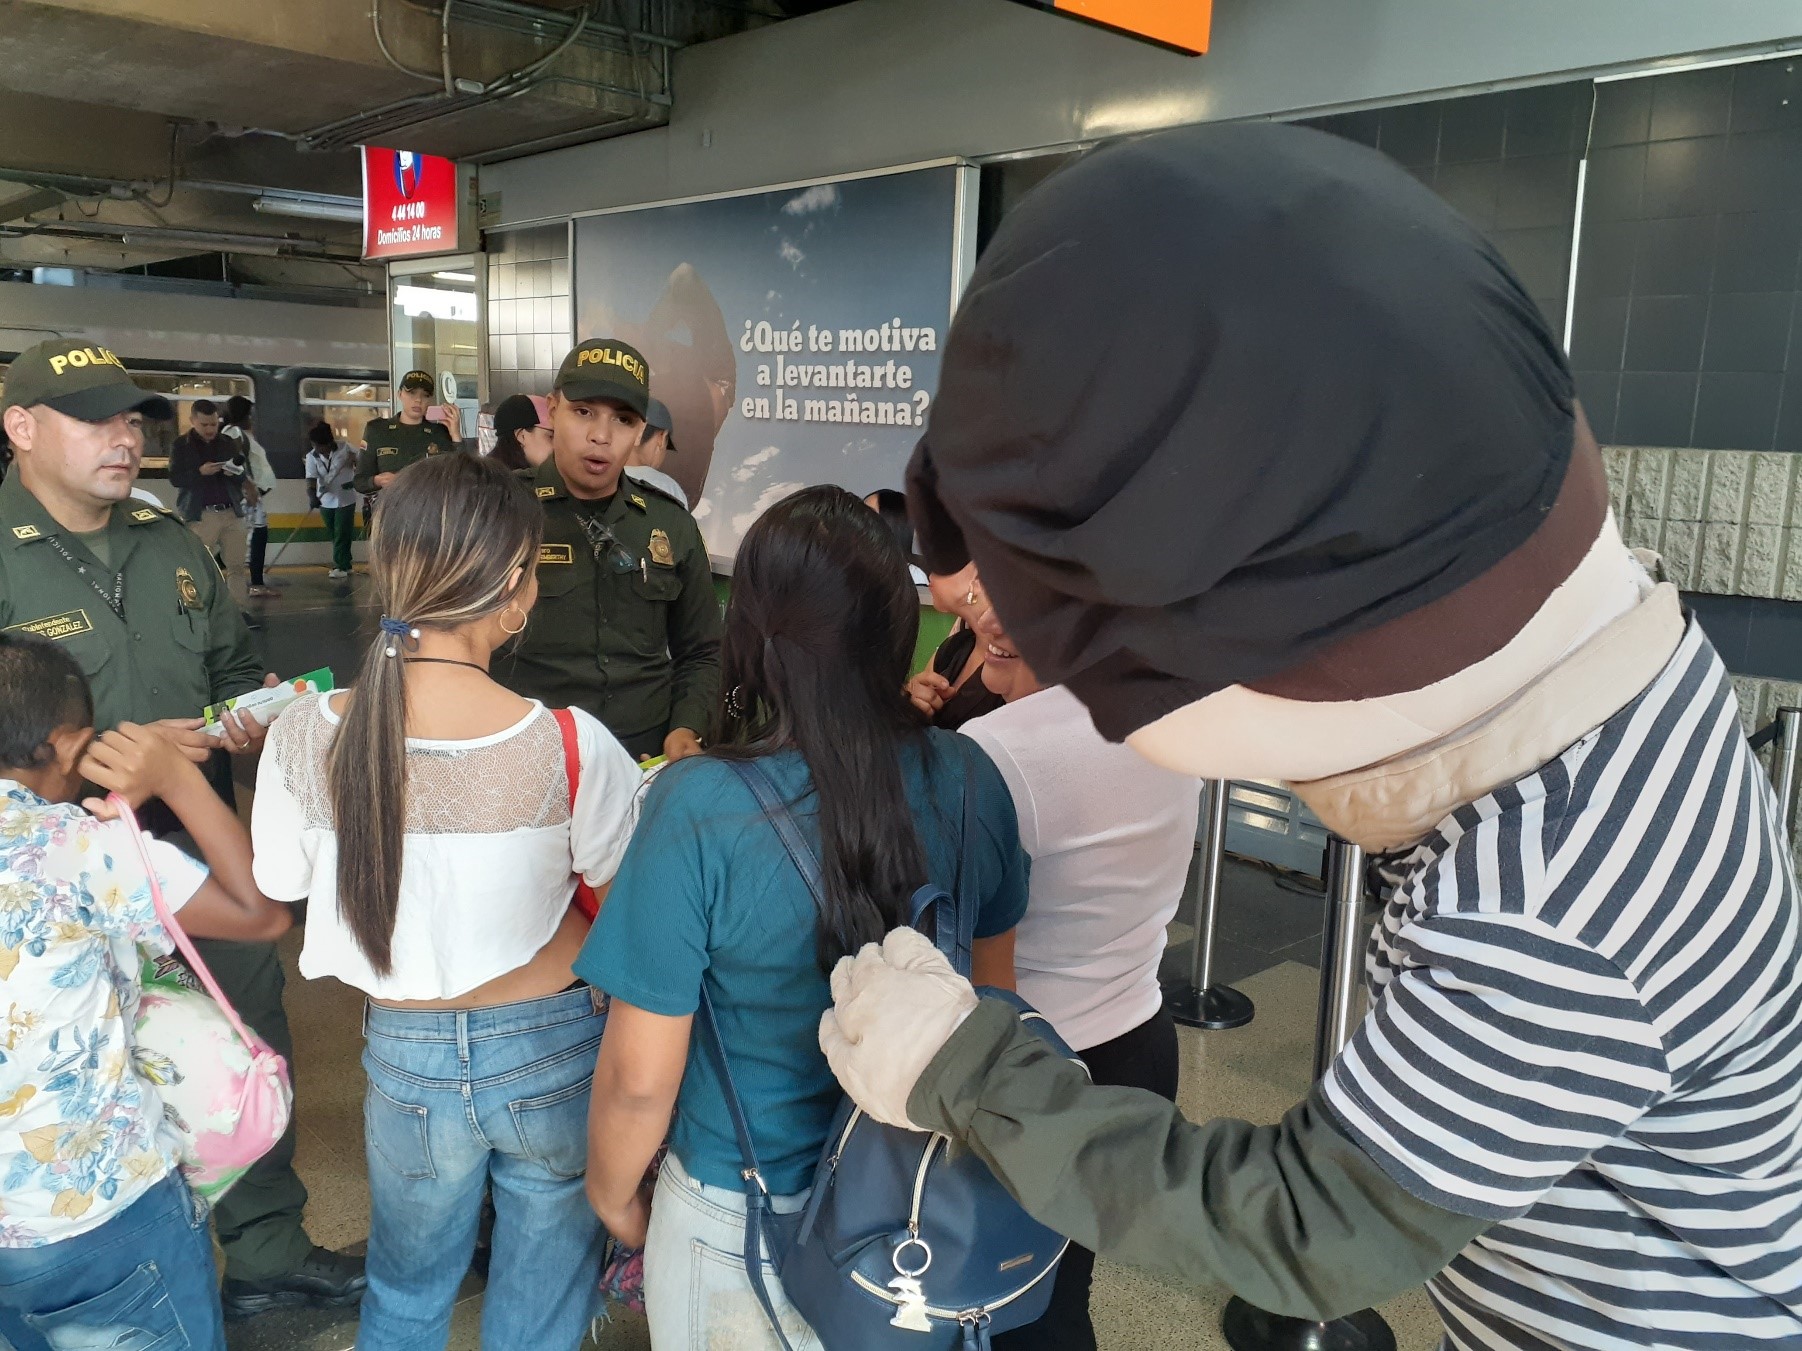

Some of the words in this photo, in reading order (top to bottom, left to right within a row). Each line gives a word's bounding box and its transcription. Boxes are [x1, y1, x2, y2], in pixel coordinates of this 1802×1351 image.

[391, 205, 397, 221] 4
[397, 203, 406, 220] 44
[407, 202, 415, 219] 14
[415, 201, 425, 218] 00
[377, 227, 411, 245] Domicilios
[412, 224, 421, 241] 24
[421, 223, 442, 240] horas
[740, 319, 803, 352] ¿Qué
[808, 324, 833, 352] te
[838, 317, 936, 352] motiva
[48, 346, 129, 376] POLIC
[577, 348, 645, 385] POLICIA
[756, 364, 771, 386] a
[776, 354, 913, 389] levantarte
[741, 396, 770, 419] en
[775, 388, 798, 420] la
[804, 389, 930, 426] mañana?
[46, 620, 84, 637] GONZALEZ
